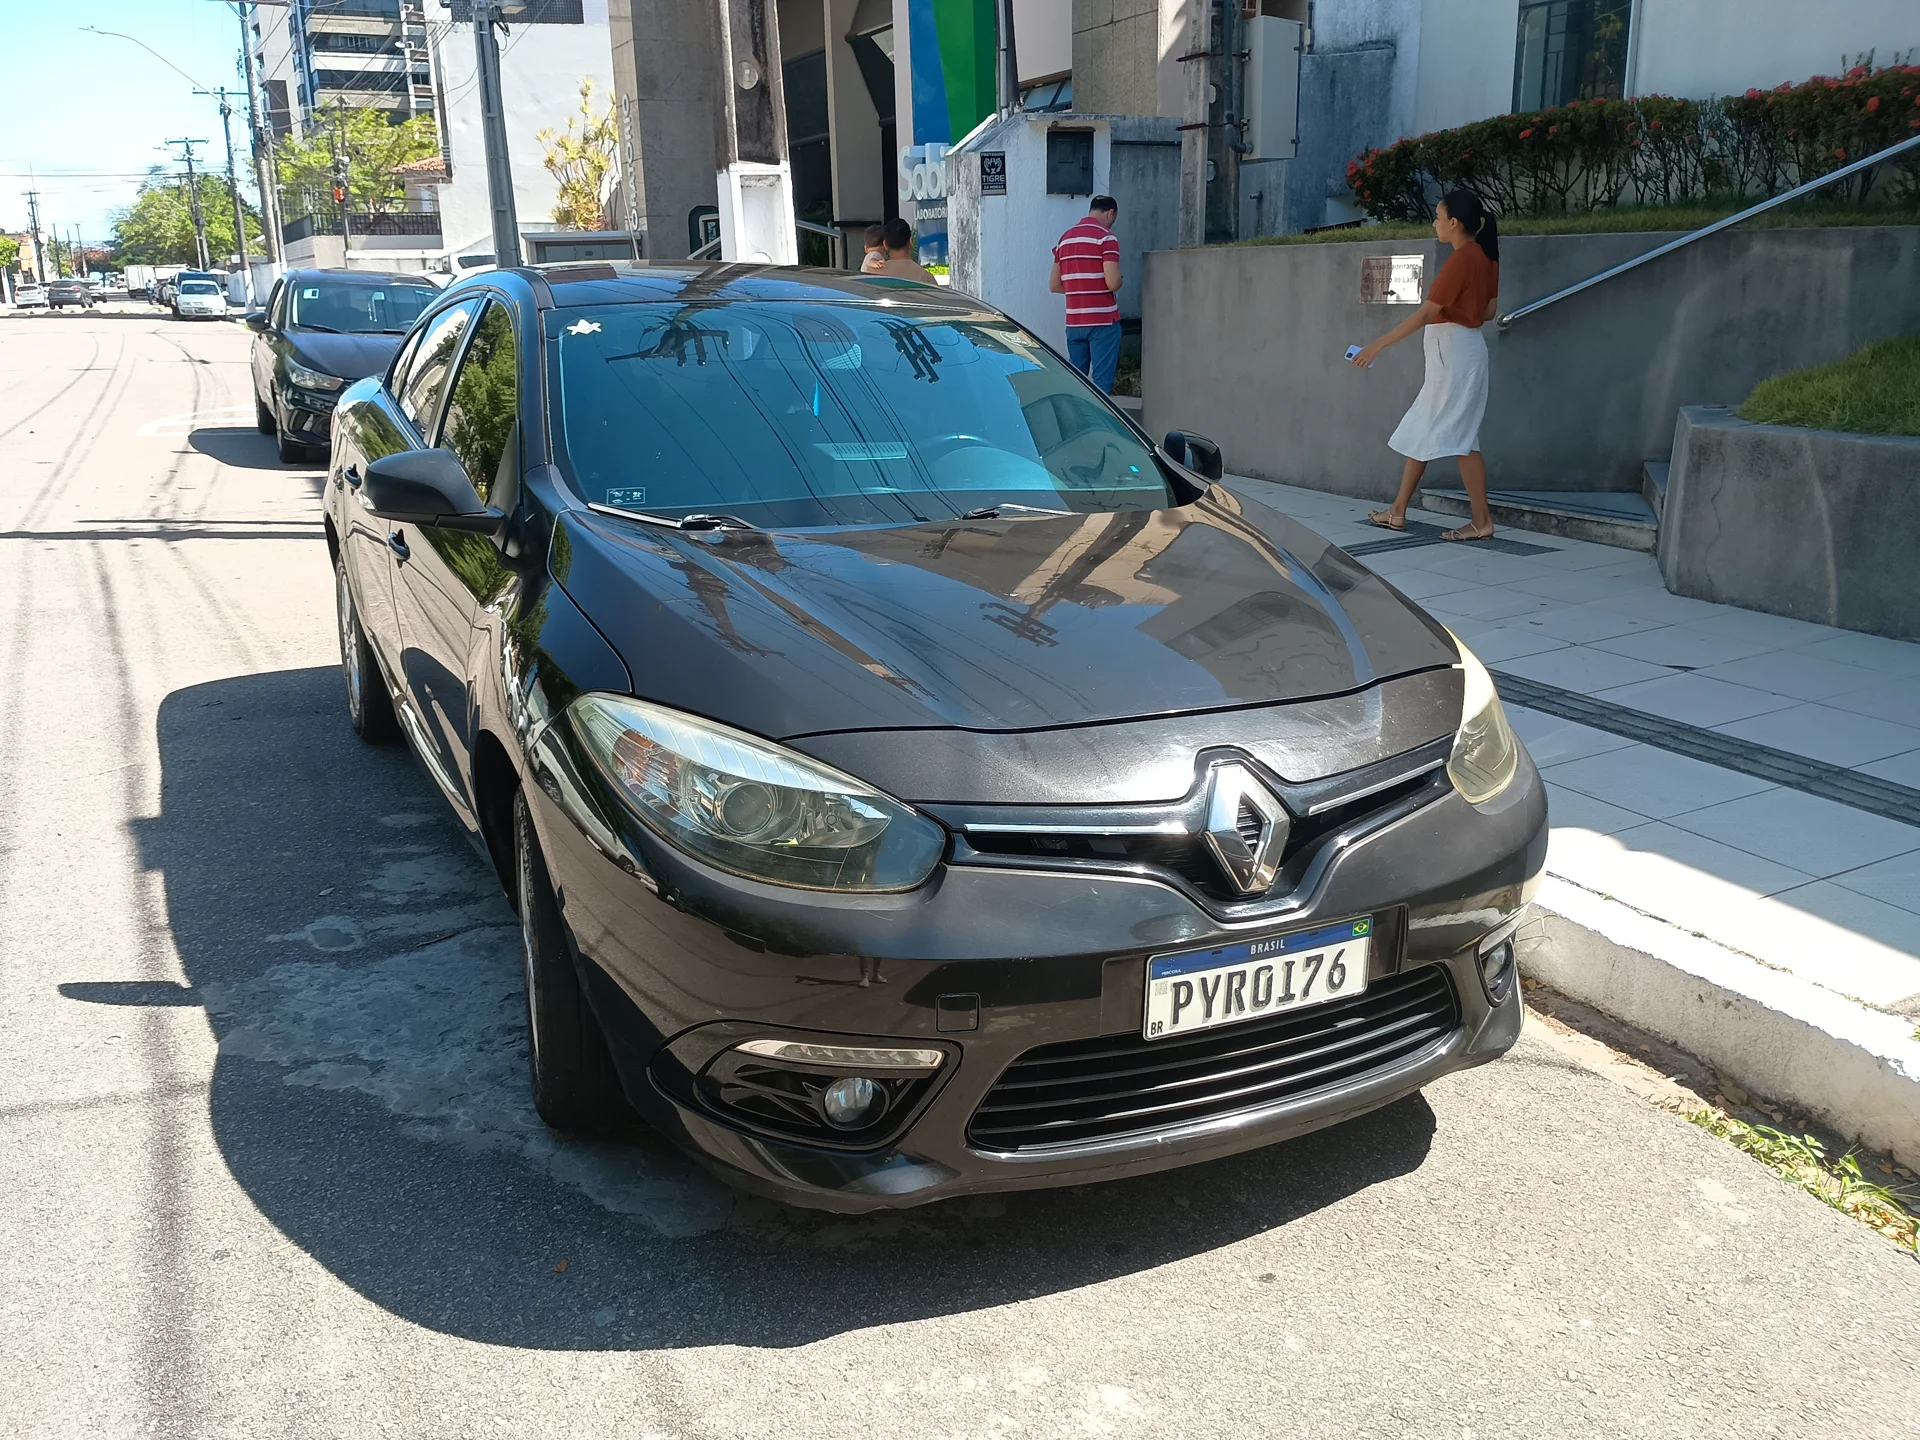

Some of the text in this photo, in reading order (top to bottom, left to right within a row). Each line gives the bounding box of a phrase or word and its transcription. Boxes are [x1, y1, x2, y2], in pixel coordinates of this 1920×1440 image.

[982, 174, 1005, 183] TIGRE
[1365, 262, 1386, 270] cesso
[1250, 939, 1285, 955] BRASIL
[1150, 1020, 1164, 1036] BR
